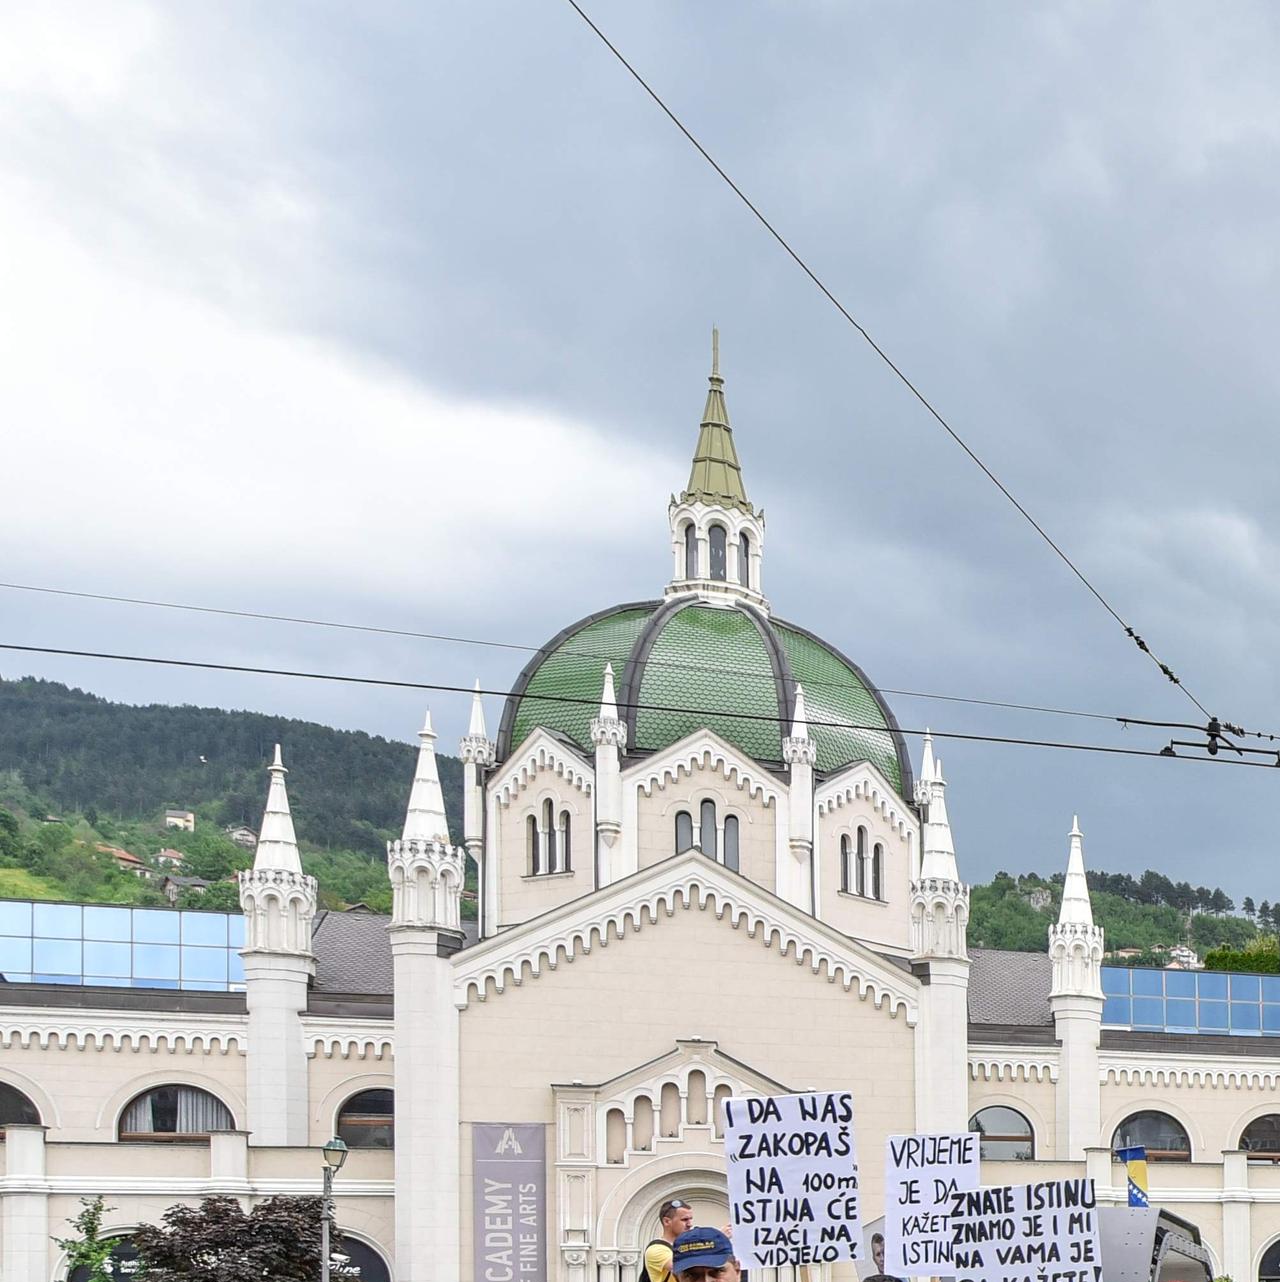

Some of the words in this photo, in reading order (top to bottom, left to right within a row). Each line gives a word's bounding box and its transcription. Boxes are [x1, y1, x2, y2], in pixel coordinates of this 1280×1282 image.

[726, 1100, 734, 1127] I
[747, 1097, 782, 1124] DA
[799, 1094, 852, 1123] NAS
[891, 1136, 973, 1169] VRIJEME
[746, 1167, 784, 1194] NA
[899, 1180, 921, 1205] JE
[934, 1178, 958, 1204] DA
[518, 1183, 537, 1226] ARTS
[734, 1198, 815, 1225] ISTINA
[827, 1191, 857, 1220] ĆE
[950, 1186, 1015, 1217] ZNATE
[1027, 1179, 1096, 1210] ISTINU
[754, 1224, 807, 1246] IZAĆI
[820, 1224, 852, 1243] NA
[902, 1212, 951, 1236] KAŽET
[951, 1218, 1015, 1245] ZNAMO
[1022, 1215, 1044, 1237] JE
[1053, 1215, 1058, 1235] I
[520, 1234, 538, 1272] FINE
[955, 1250, 984, 1268] NA
[996, 1243, 1061, 1266] VAMA
[1070, 1240, 1094, 1263] JE
